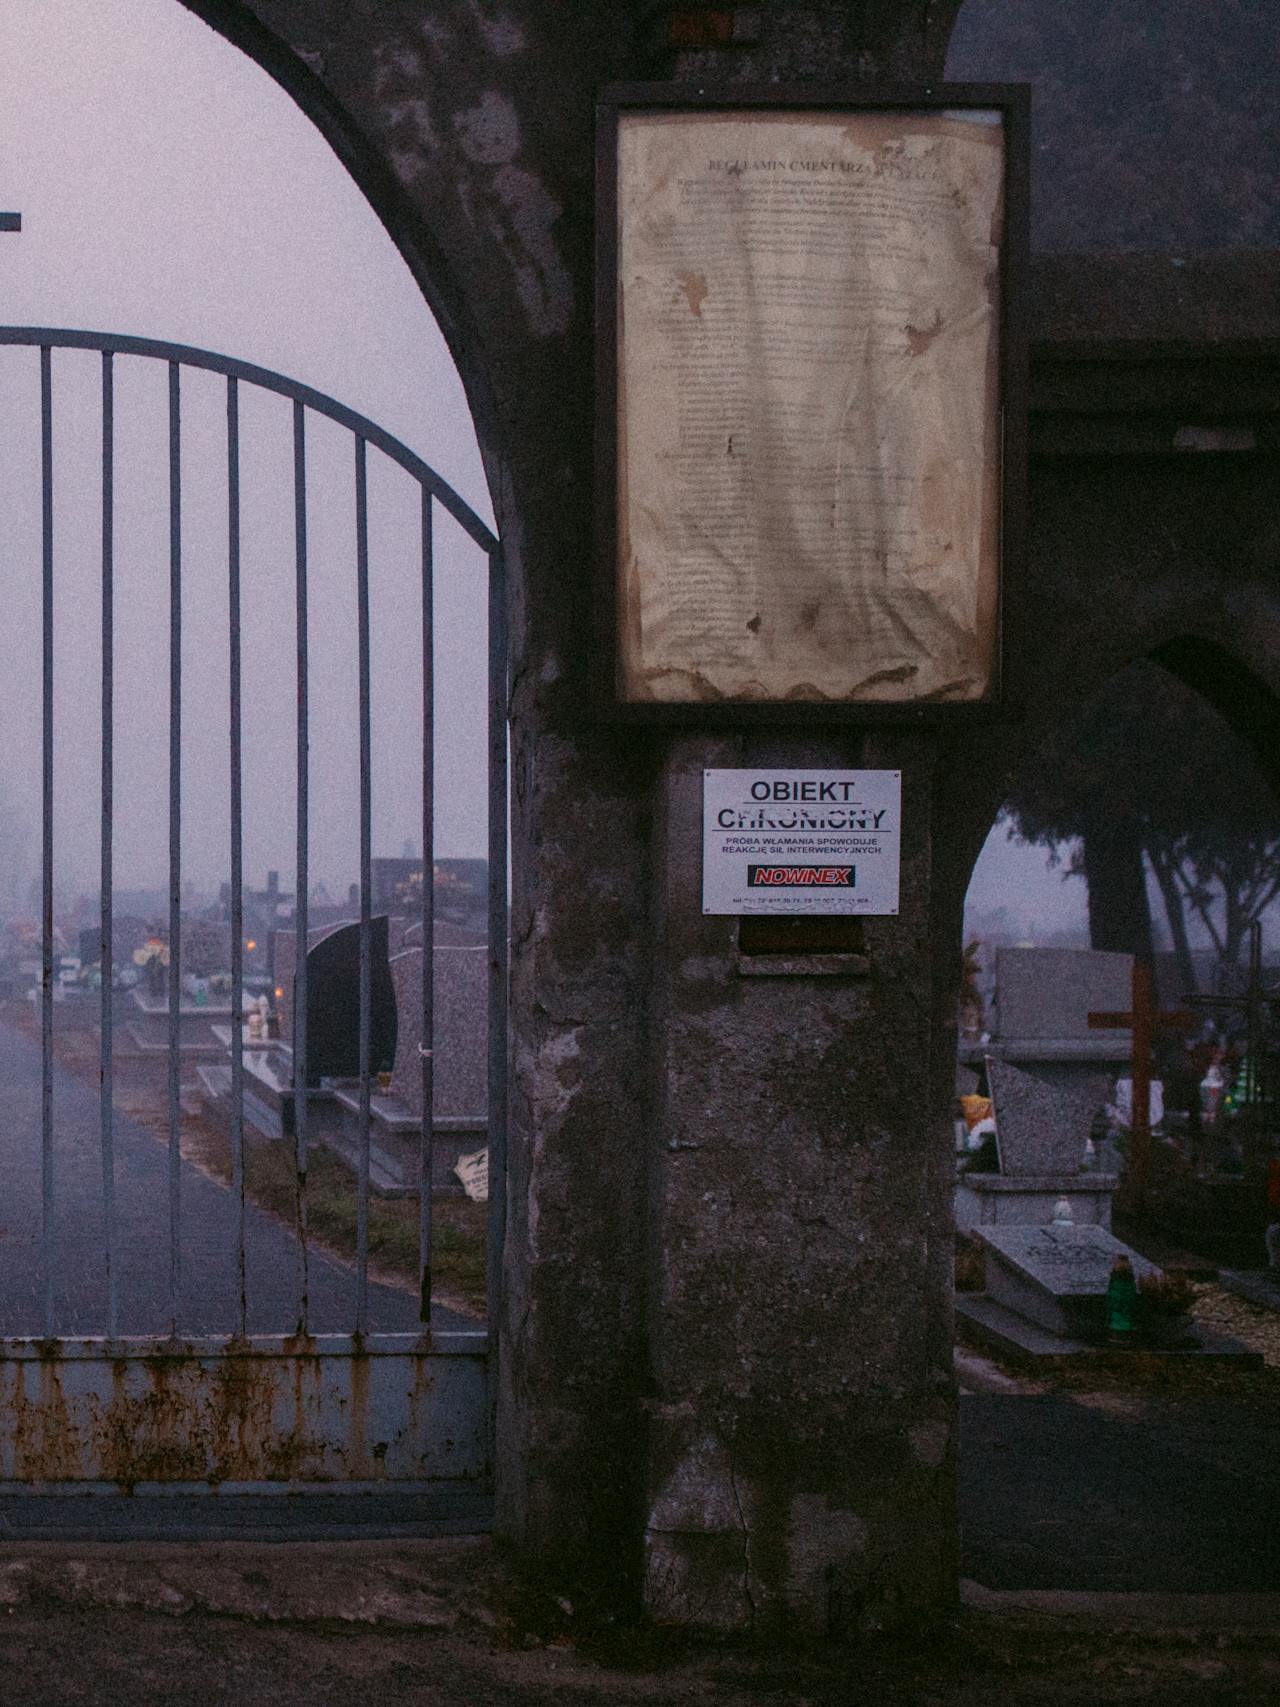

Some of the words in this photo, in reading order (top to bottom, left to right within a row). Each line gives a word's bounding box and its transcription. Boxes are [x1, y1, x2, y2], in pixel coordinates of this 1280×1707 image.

[751, 781, 855, 801] OBIEKT
[726, 836, 760, 845] PRÓBA
[763, 837, 814, 845] WŁAMANIA
[817, 837, 878, 846] SPOWODUJE
[754, 868, 851, 885] NOWINEX
